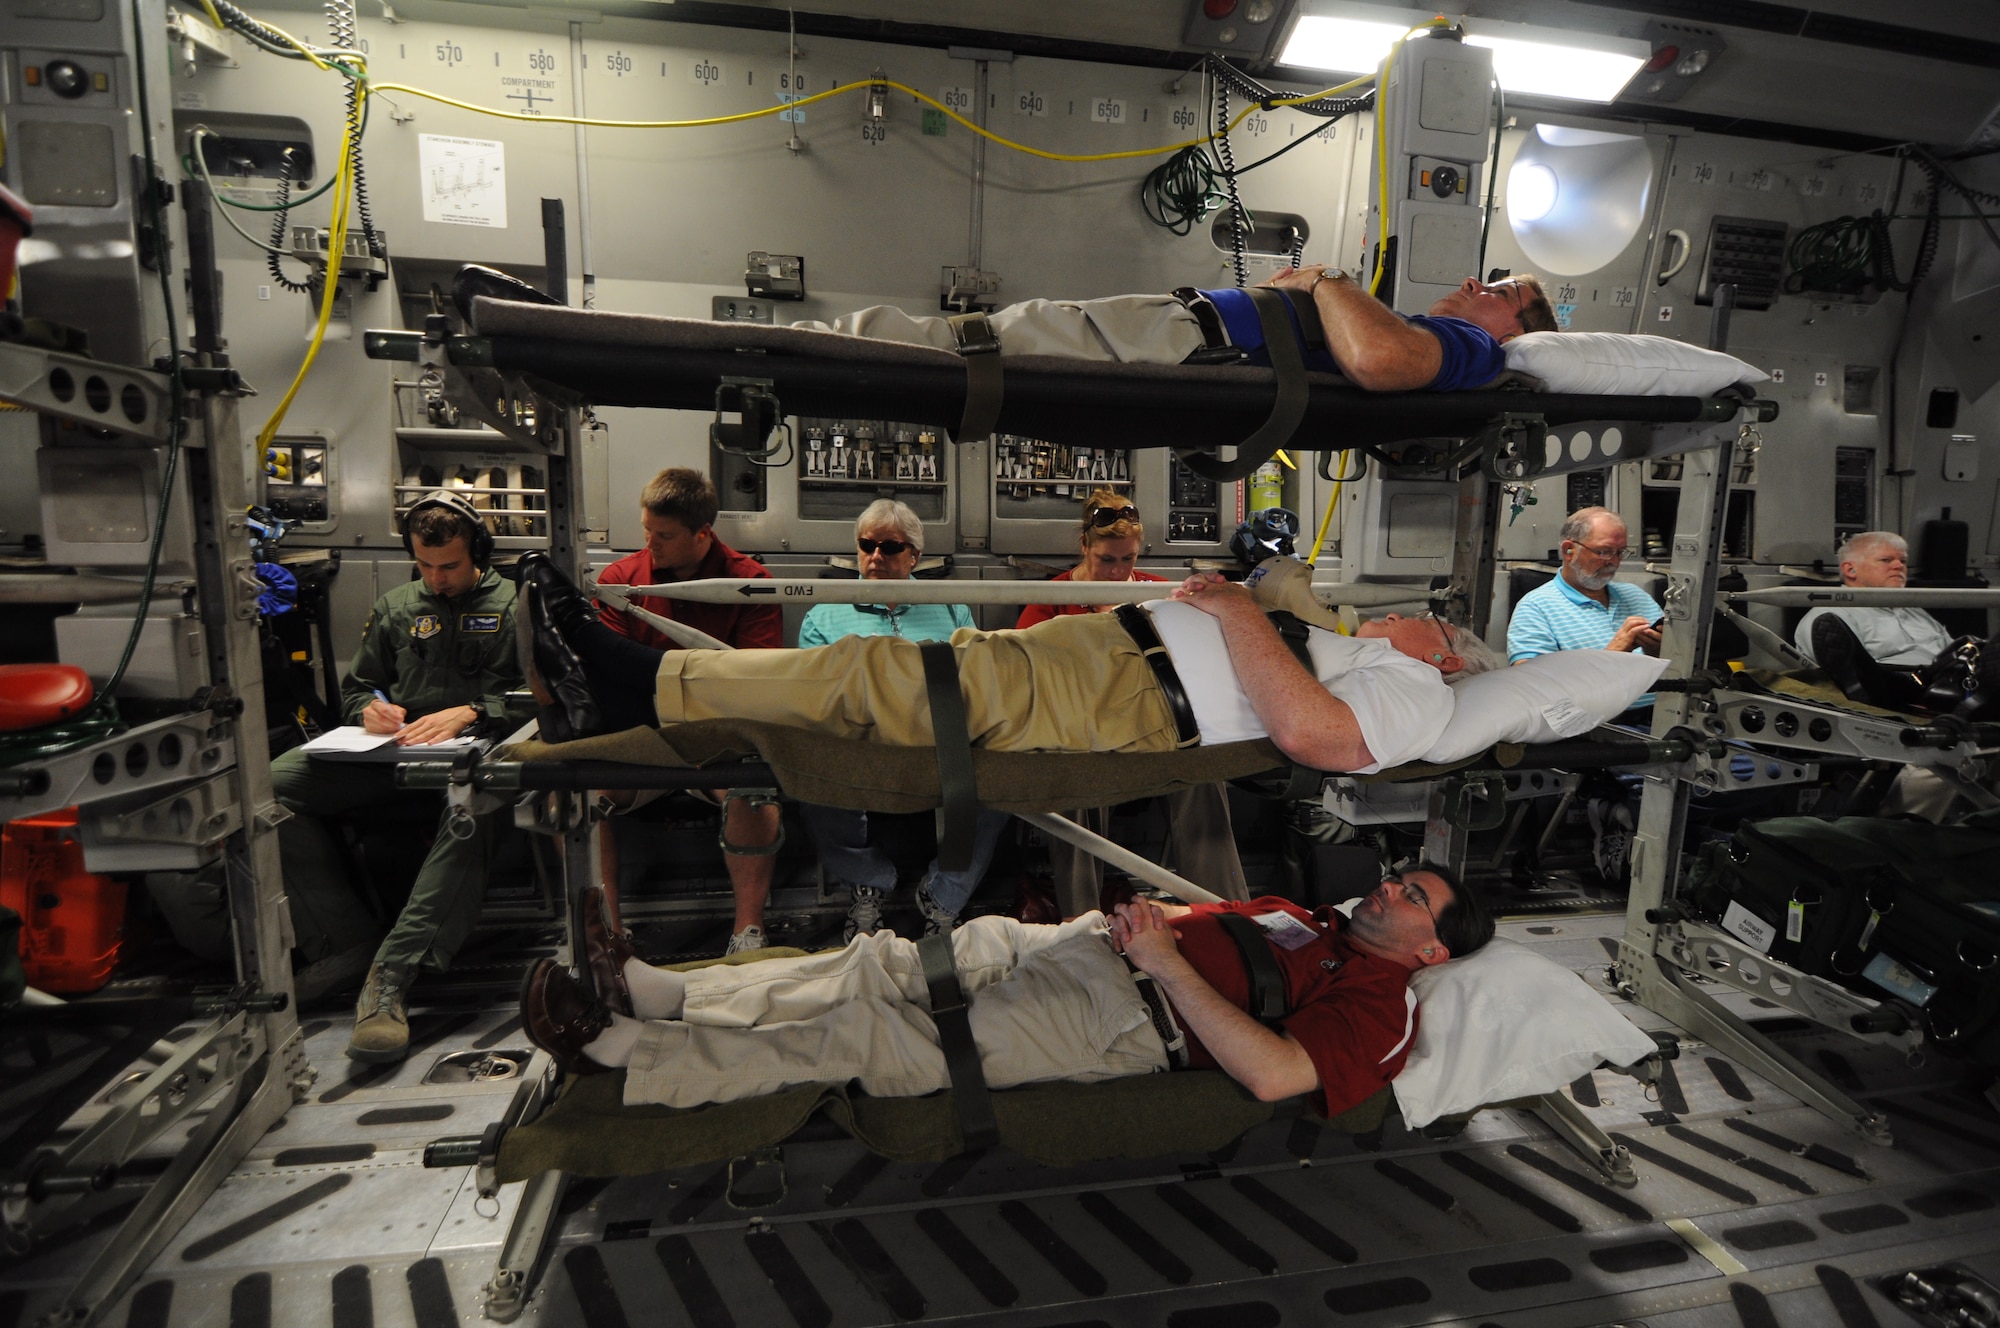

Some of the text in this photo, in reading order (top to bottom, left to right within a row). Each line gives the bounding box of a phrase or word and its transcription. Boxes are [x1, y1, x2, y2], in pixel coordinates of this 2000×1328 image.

[436, 45, 463, 62] 570
[529, 54, 554, 70] 580
[607, 55, 631, 72] 590
[695, 64, 719, 81] 600
[501, 77, 555, 89] COMPARTMENT
[780, 73, 804, 90] 60
[945, 92, 968, 107] 630
[1020, 96, 1043, 112] 640
[786, 112, 799, 121] 60
[1097, 103, 1120, 119] 650
[1173, 110, 1195, 126] 660
[862, 125, 885, 141] 620
[1247, 117, 1267, 133] 670
[1694, 166, 1712, 180] 740
[1751, 172, 1768, 186] 750
[1558, 287, 1576, 300] 720
[1615, 291, 1632, 303] 730
[784, 586, 814, 596] FWD
[1738, 923, 1763, 943] SUPPORT
